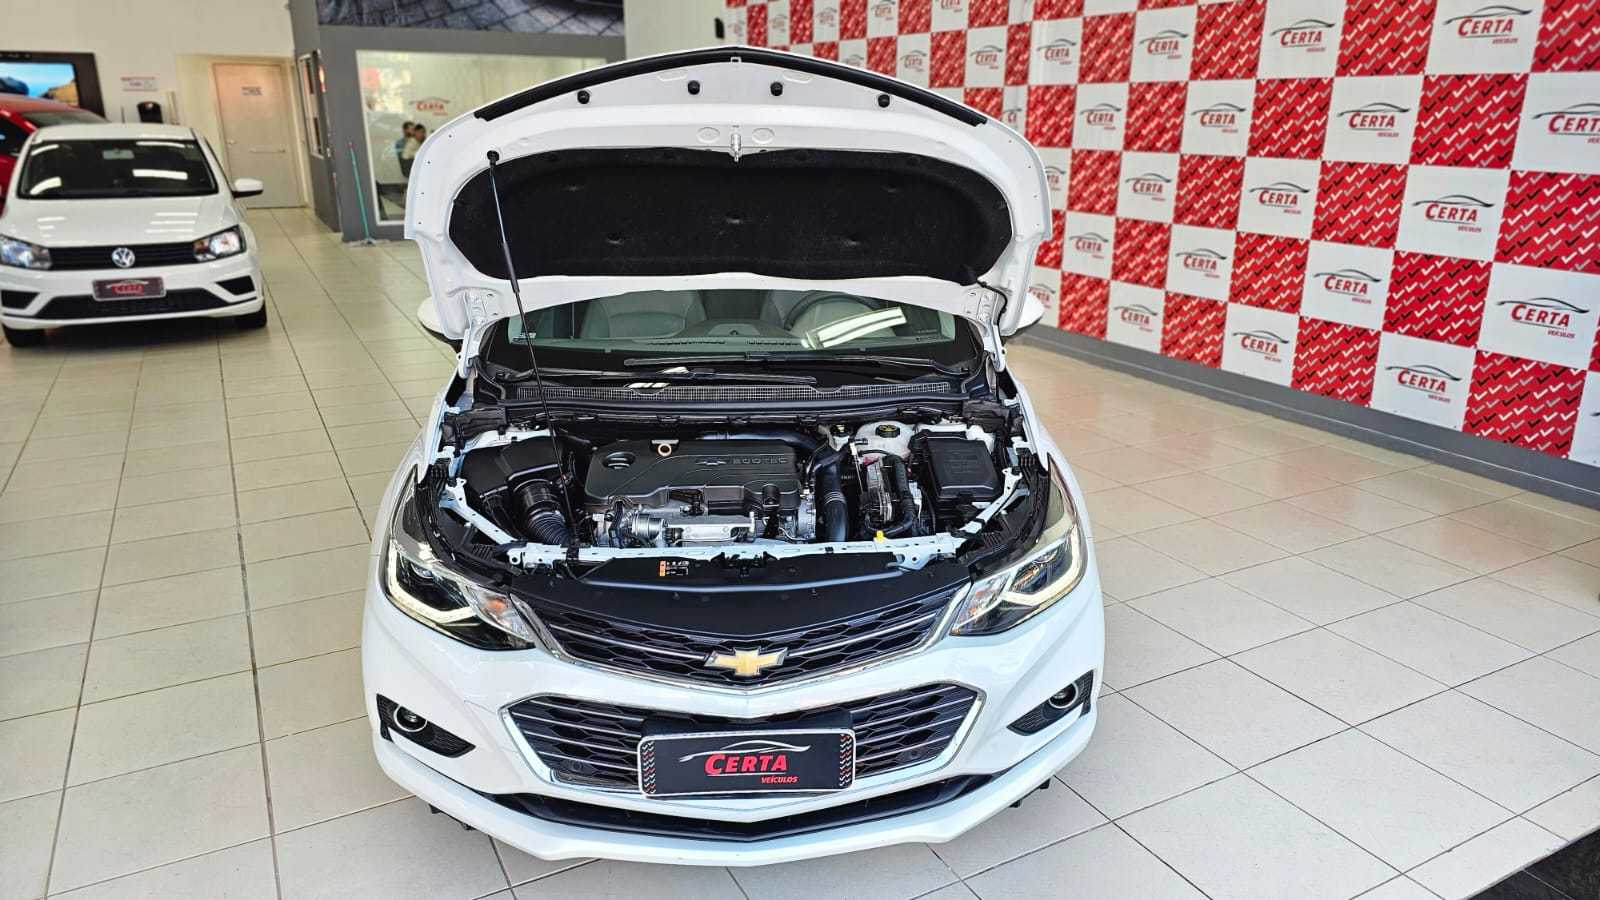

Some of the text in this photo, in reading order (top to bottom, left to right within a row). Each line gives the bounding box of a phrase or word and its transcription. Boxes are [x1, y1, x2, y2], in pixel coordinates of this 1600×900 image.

[1457, 16, 1514, 36] CERTA
[1280, 30, 1323, 46] CERTA
[1044, 47, 1070, 60] CERTA
[1147, 39, 1179, 54] CERTA
[975, 51, 998, 65] CERTA
[1086, 111, 1114, 125] CERTA
[1200, 110, 1236, 126] CERTA
[1349, 112, 1395, 128] CERTA
[1549, 113, 1600, 133] CERT
[1133, 179, 1163, 194] CERTA
[1259, 189, 1298, 206] CERTA
[1425, 203, 1478, 222] CERTA
[1075, 238, 1102, 251] CERTA
[1184, 255, 1217, 271] CERTA
[1324, 276, 1368, 295] CERTA
[1121, 308, 1149, 324] CERTA
[1511, 304, 1570, 327] CERTA
[1241, 335, 1278, 353] CERTA
[1397, 368, 1446, 392] CERTA
[704, 753, 788, 775] CERTA
[761, 775, 798, 784] VEÍCULOS
